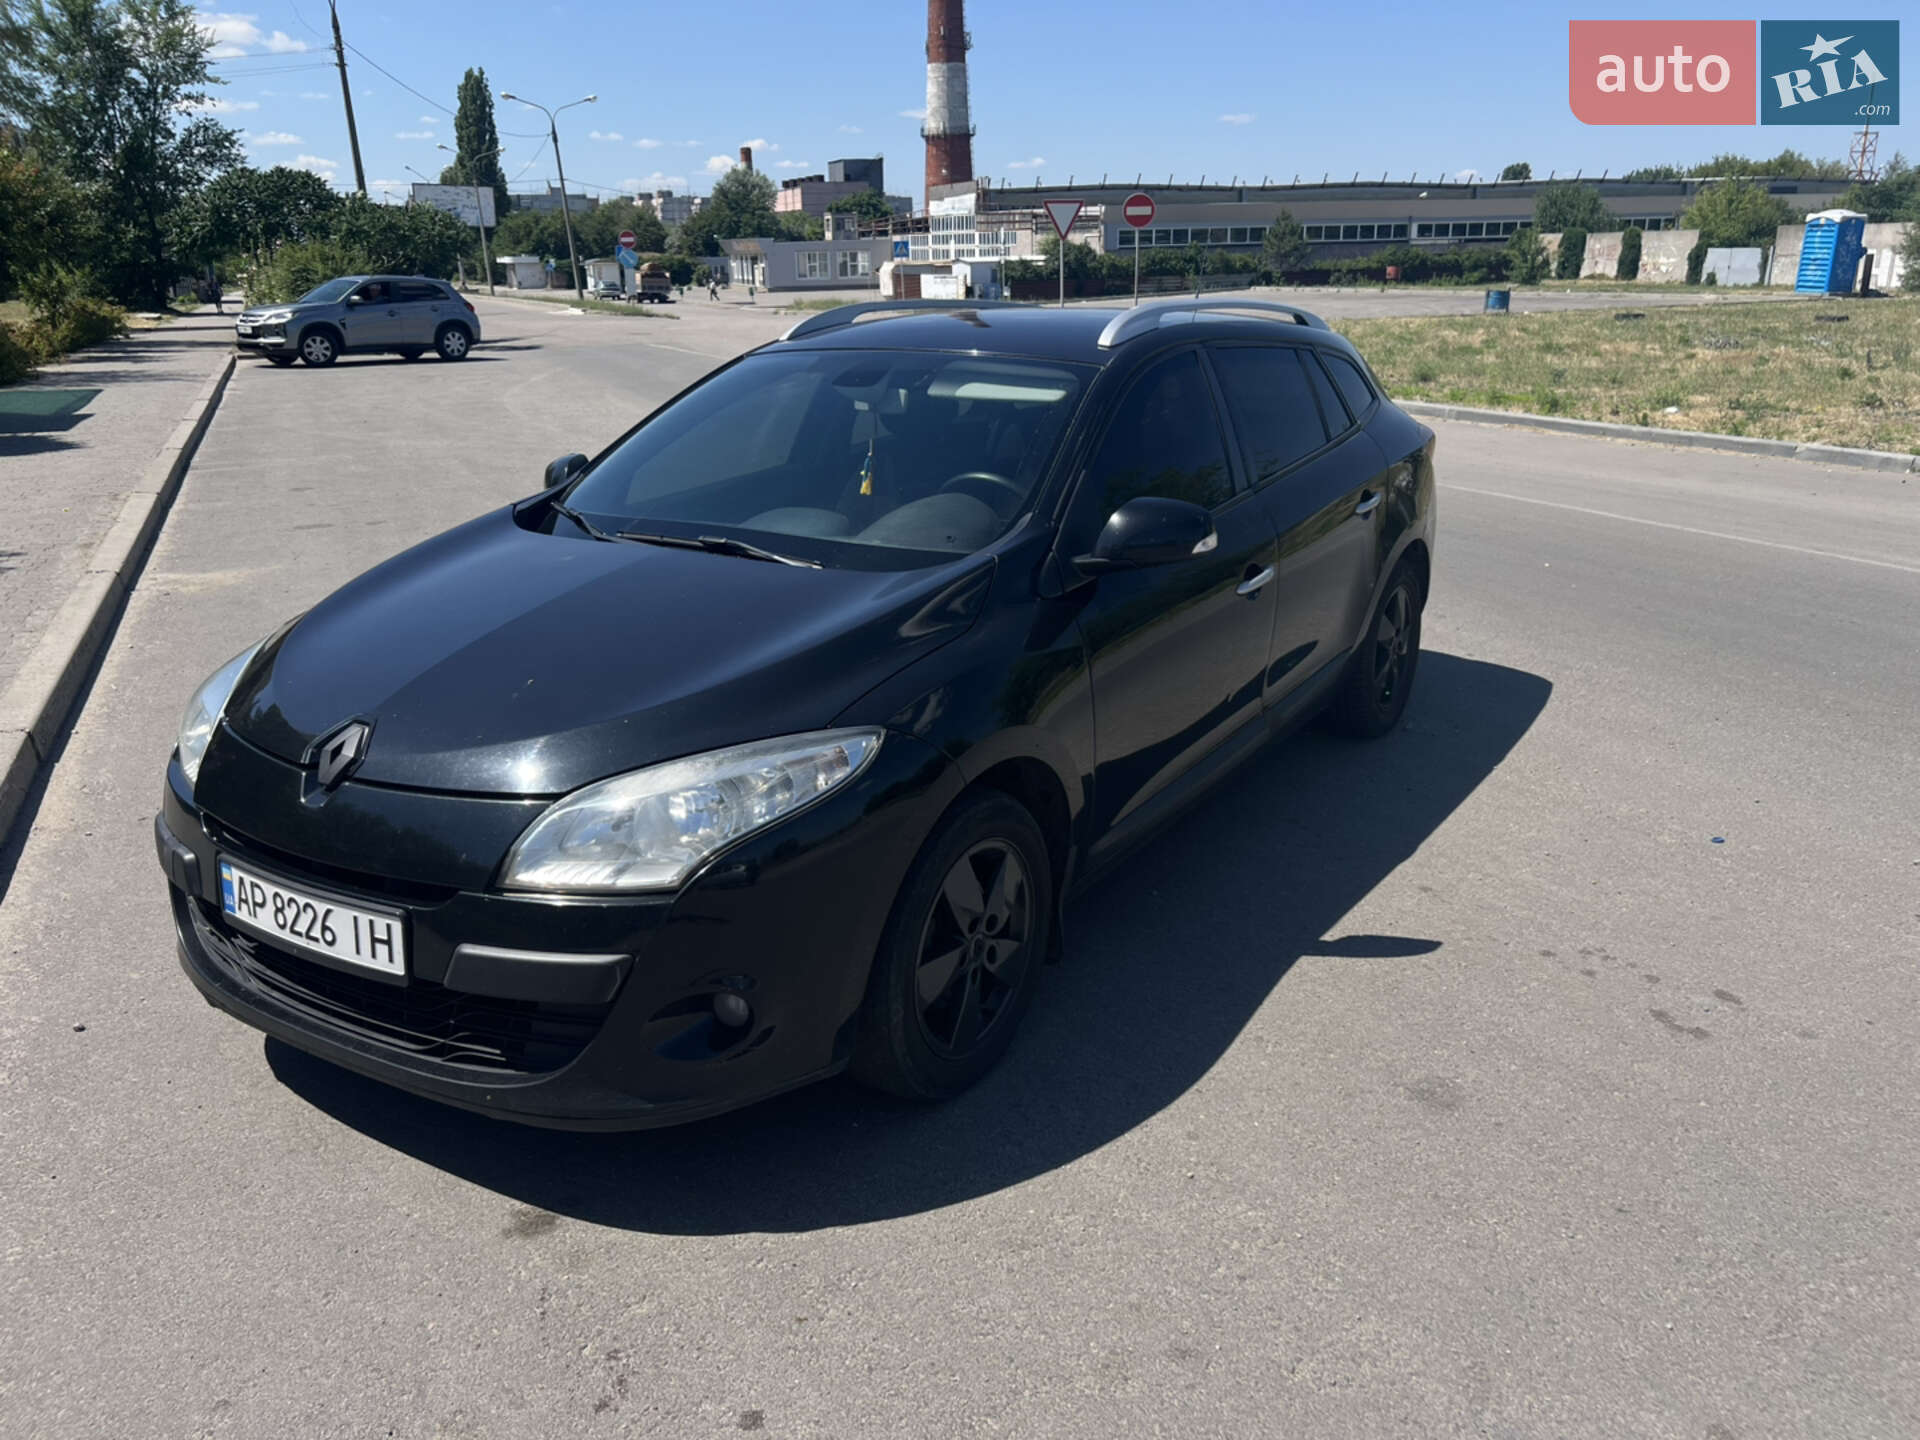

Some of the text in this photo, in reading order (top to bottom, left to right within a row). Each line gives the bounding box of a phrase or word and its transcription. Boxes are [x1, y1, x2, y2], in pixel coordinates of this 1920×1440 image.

[237, 875, 395, 965] AP 8226 IH
